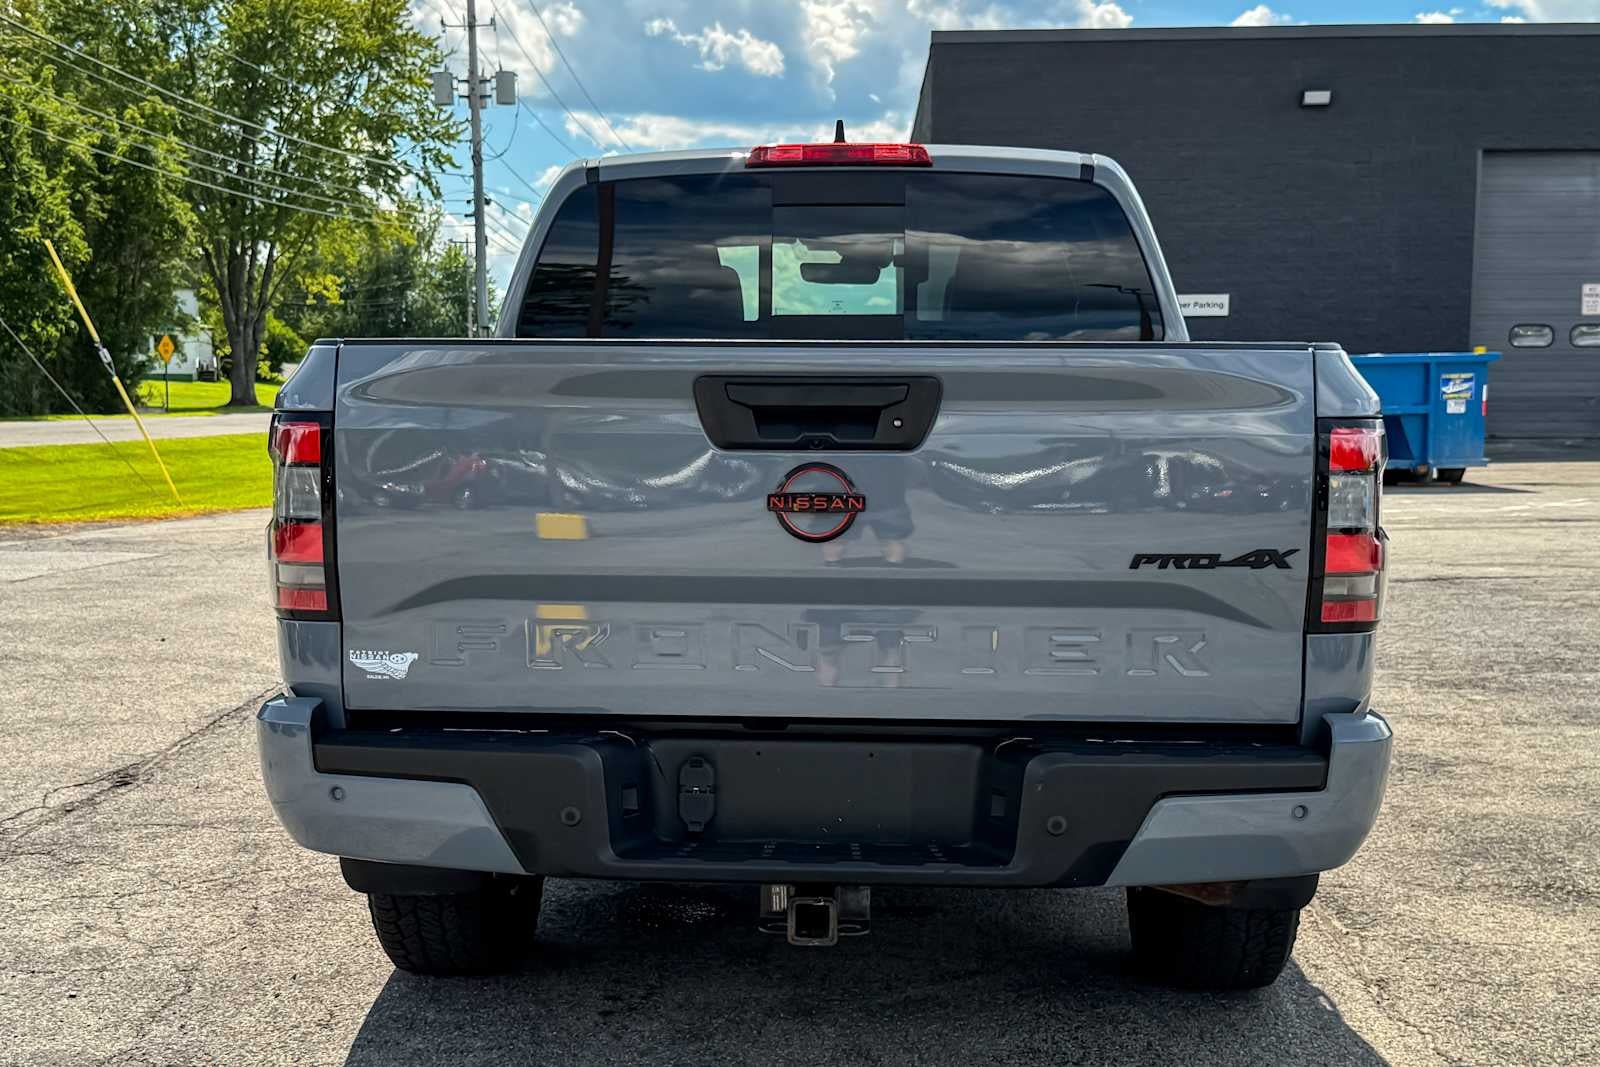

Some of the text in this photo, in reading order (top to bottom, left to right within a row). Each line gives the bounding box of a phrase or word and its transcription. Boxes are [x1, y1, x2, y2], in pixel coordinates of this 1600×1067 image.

[1193, 301, 1224, 310] Parking
[768, 496, 865, 510] NISSAN
[429, 615, 1210, 677] FRONTIER
